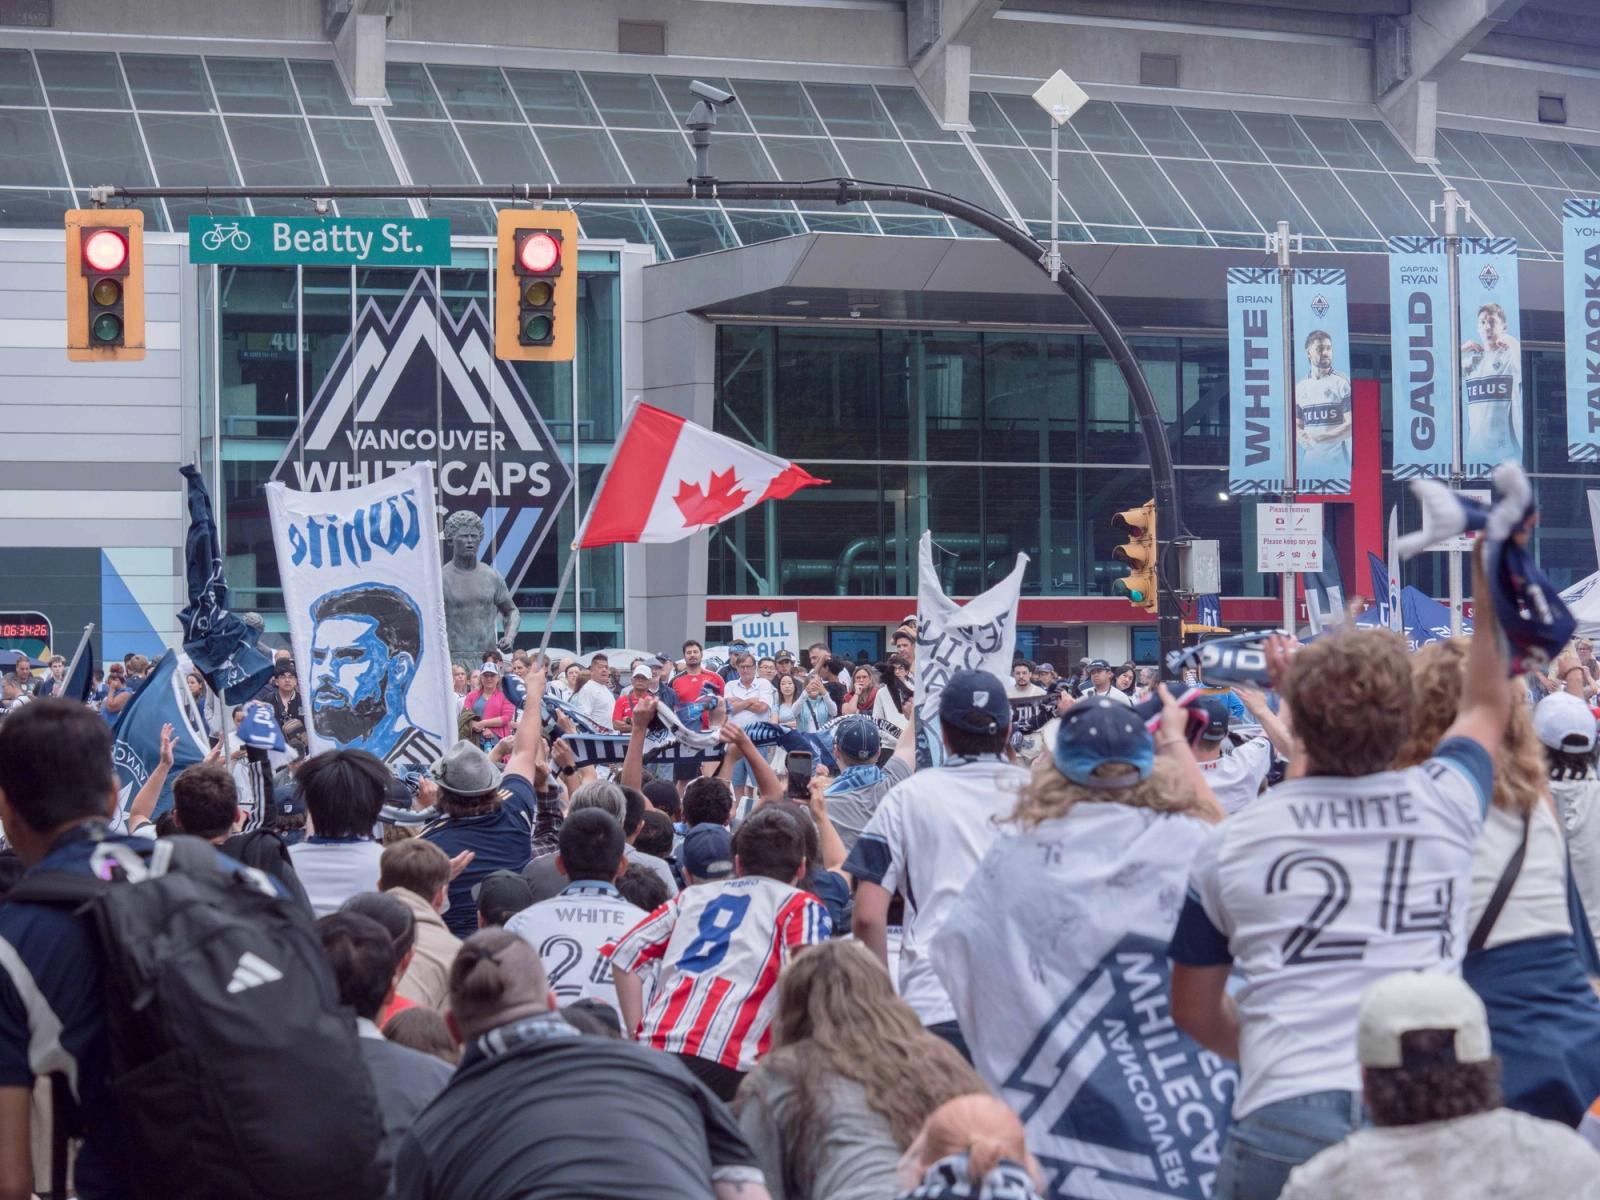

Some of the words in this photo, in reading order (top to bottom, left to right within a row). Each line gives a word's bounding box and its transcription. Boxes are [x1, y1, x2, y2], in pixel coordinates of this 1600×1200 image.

[273, 222, 374, 260] Beatty
[381, 223, 423, 253] St.
[1401, 275, 1438, 285] RYAN
[1236, 295, 1273, 304] BRIAN
[1408, 291, 1436, 451] GAULD
[1243, 309, 1271, 467] WHITE
[1468, 383, 1507, 397] TELUS
[345, 428, 506, 451] VANCOUVER
[742, 621, 789, 639] WILL
[1287, 792, 1418, 829] WHITE
[1265, 837, 1455, 966] 24
[555, 908, 625, 926] WHITE
[675, 894, 751, 973] 8
